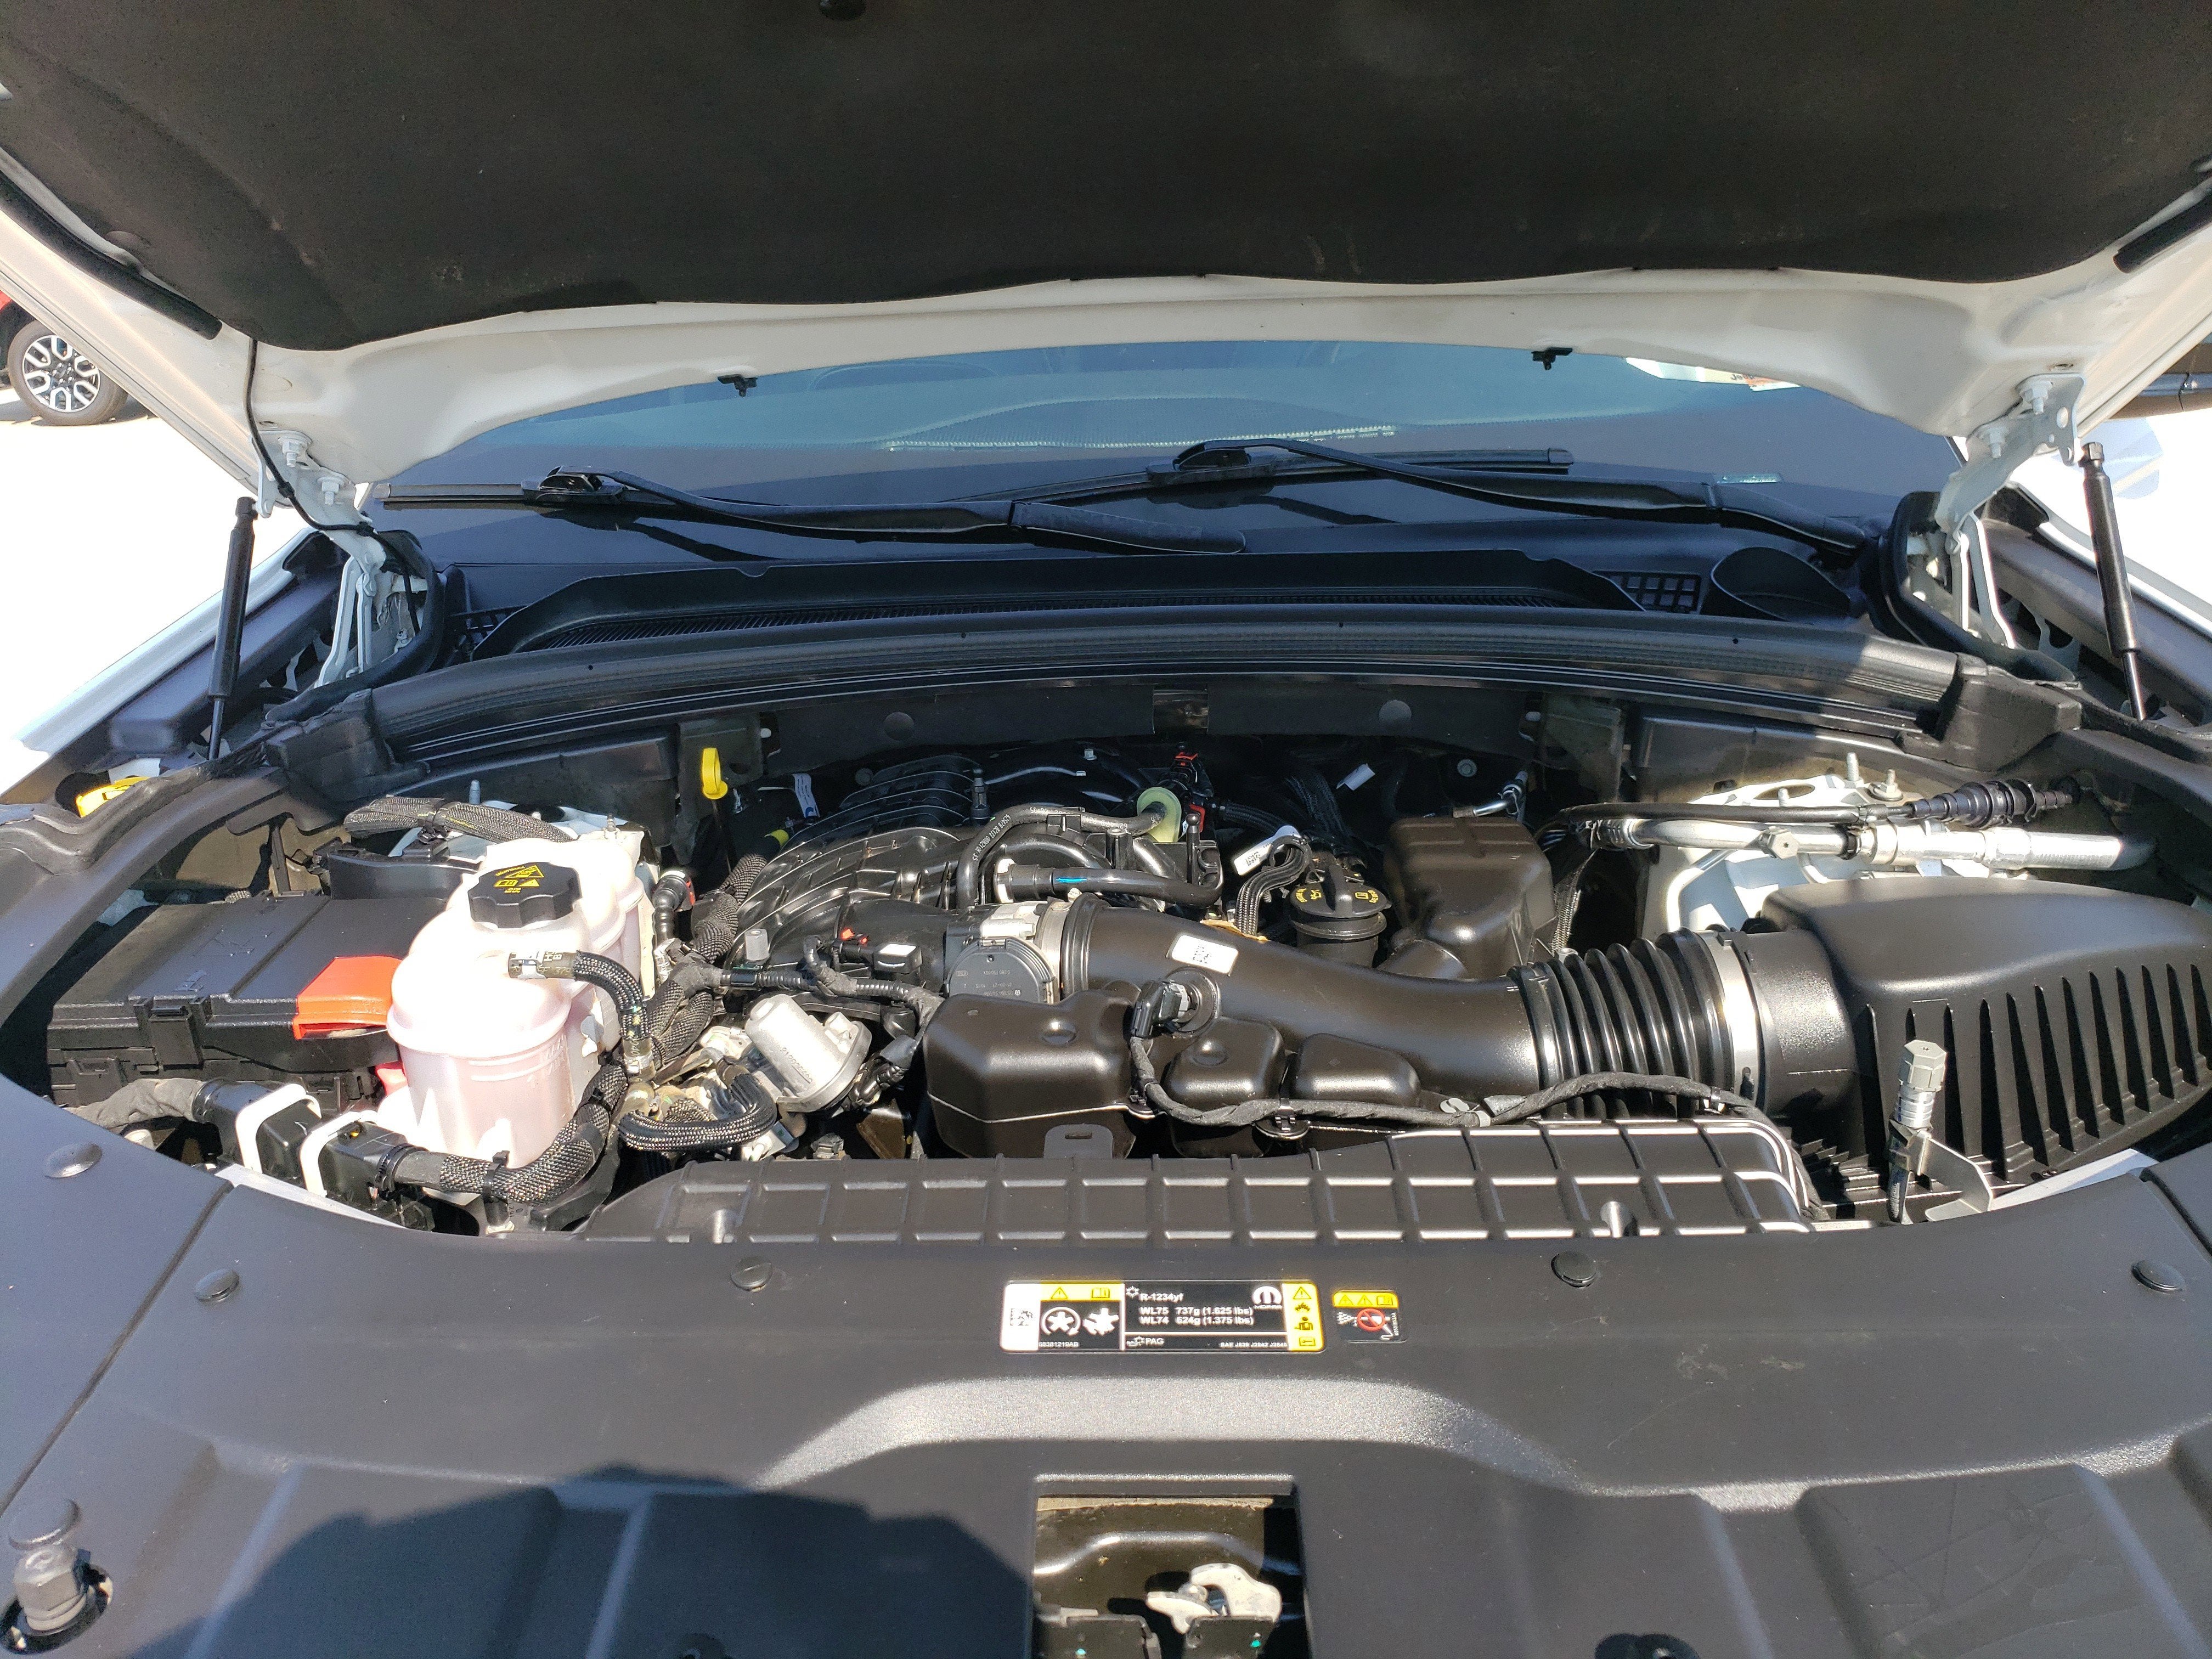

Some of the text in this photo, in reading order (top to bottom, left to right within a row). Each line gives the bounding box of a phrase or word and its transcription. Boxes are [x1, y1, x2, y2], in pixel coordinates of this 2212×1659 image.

[1139, 1293, 1183, 1302] R-1234yf
[1139, 1307, 1253, 1317] WL75 737g (1.625 lbs)
[1139, 1316, 1254, 1326] WL74 624g (1.375 lbs)
